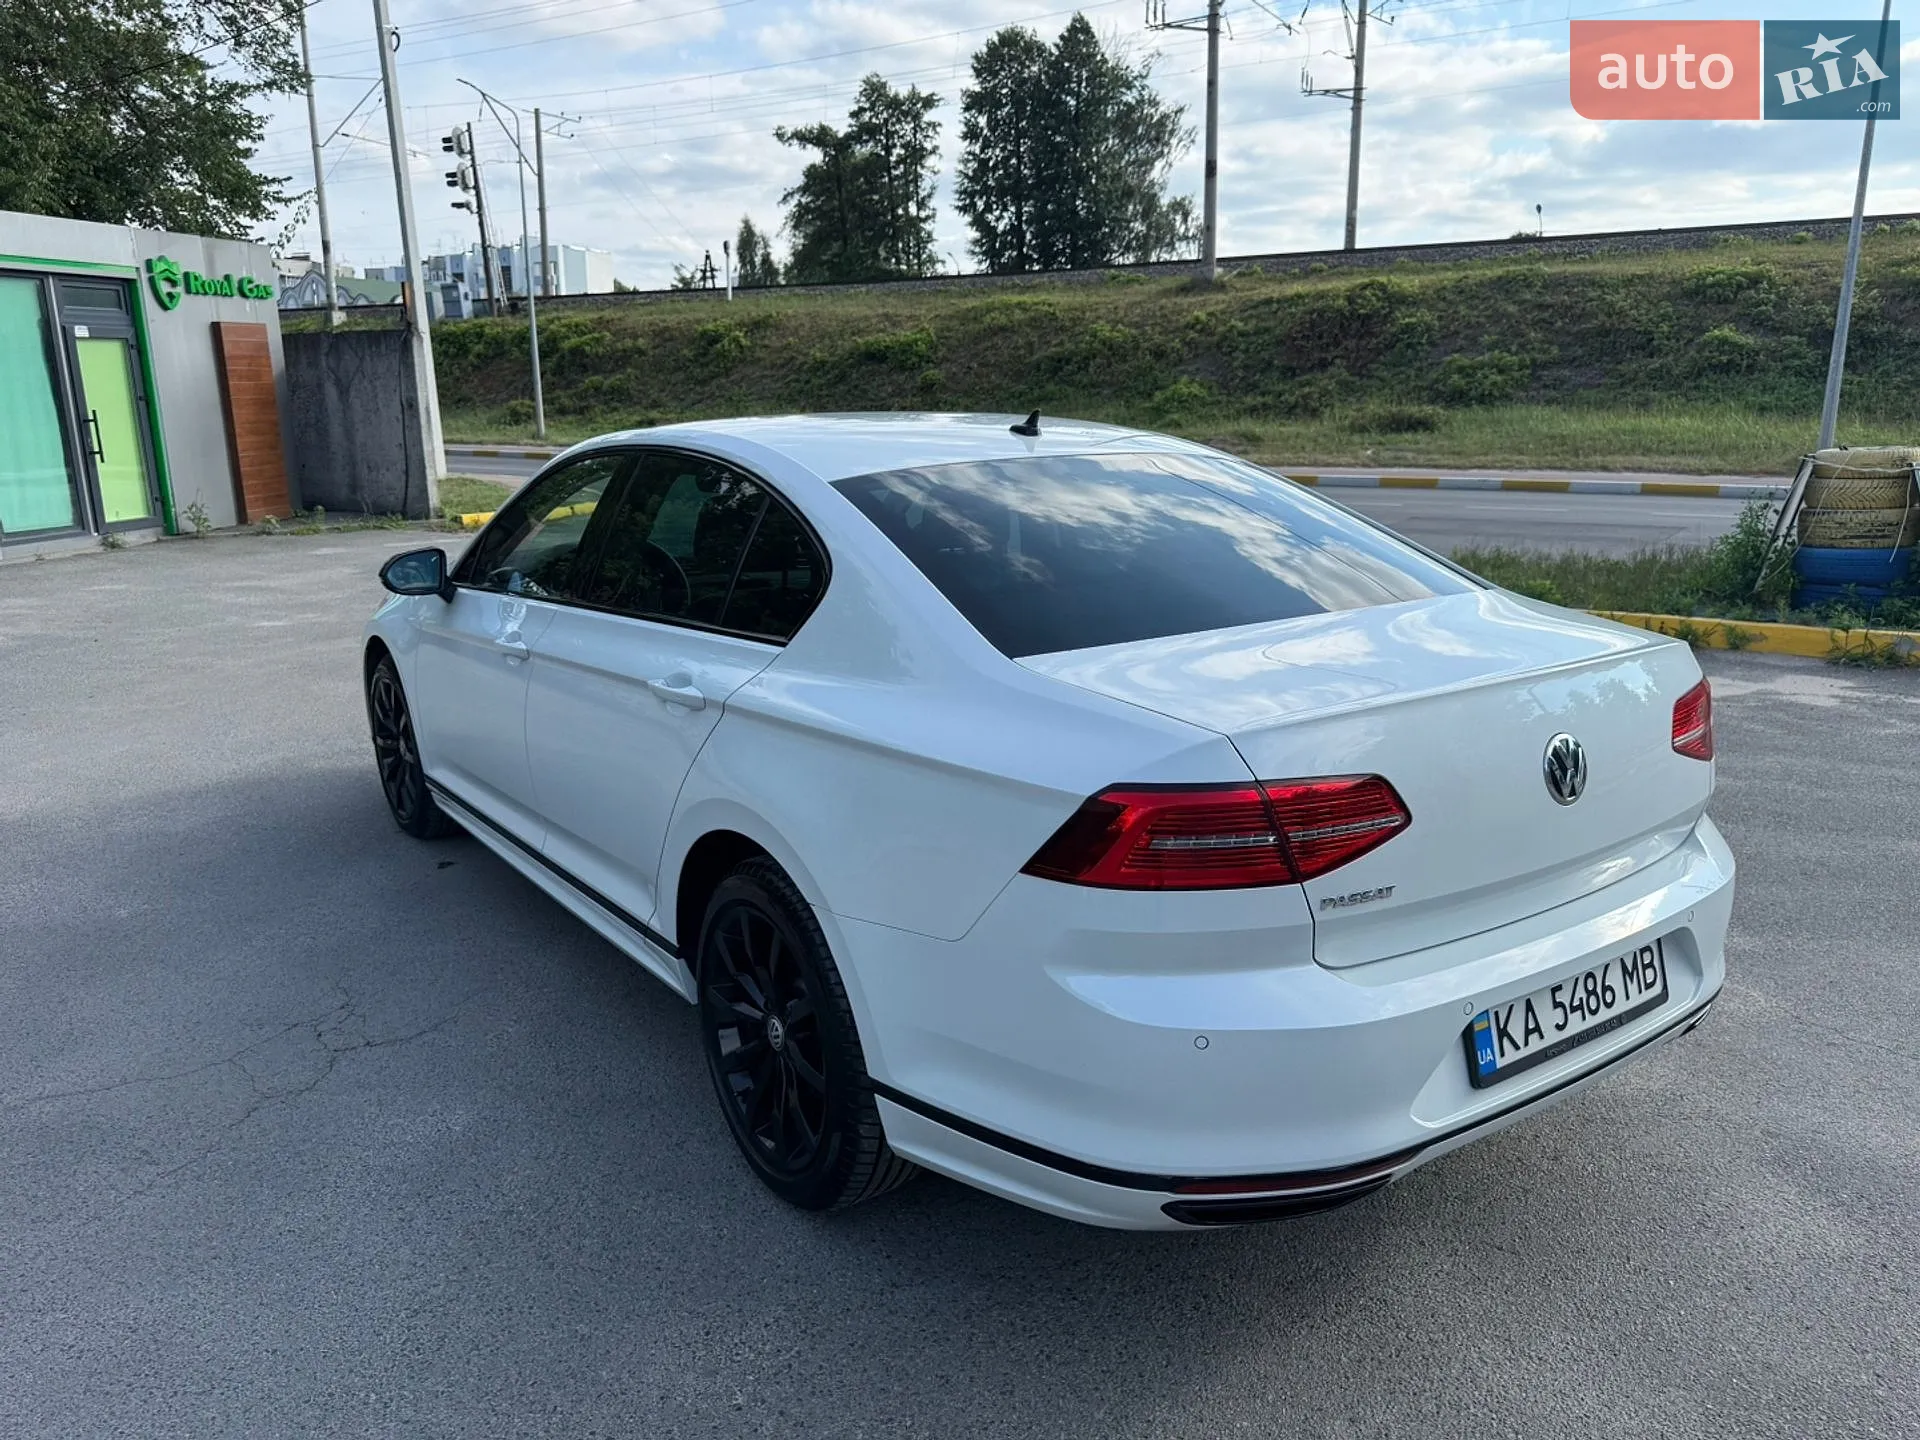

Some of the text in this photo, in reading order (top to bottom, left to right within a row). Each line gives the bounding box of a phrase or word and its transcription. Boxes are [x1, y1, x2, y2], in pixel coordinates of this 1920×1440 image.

[1320, 884, 1396, 912] PASSAT
[1494, 998, 1545, 1058] KA
[1550, 962, 1616, 1031] 5486
[1620, 945, 1658, 1001] MB
[1478, 1047, 1494, 1066] UA
